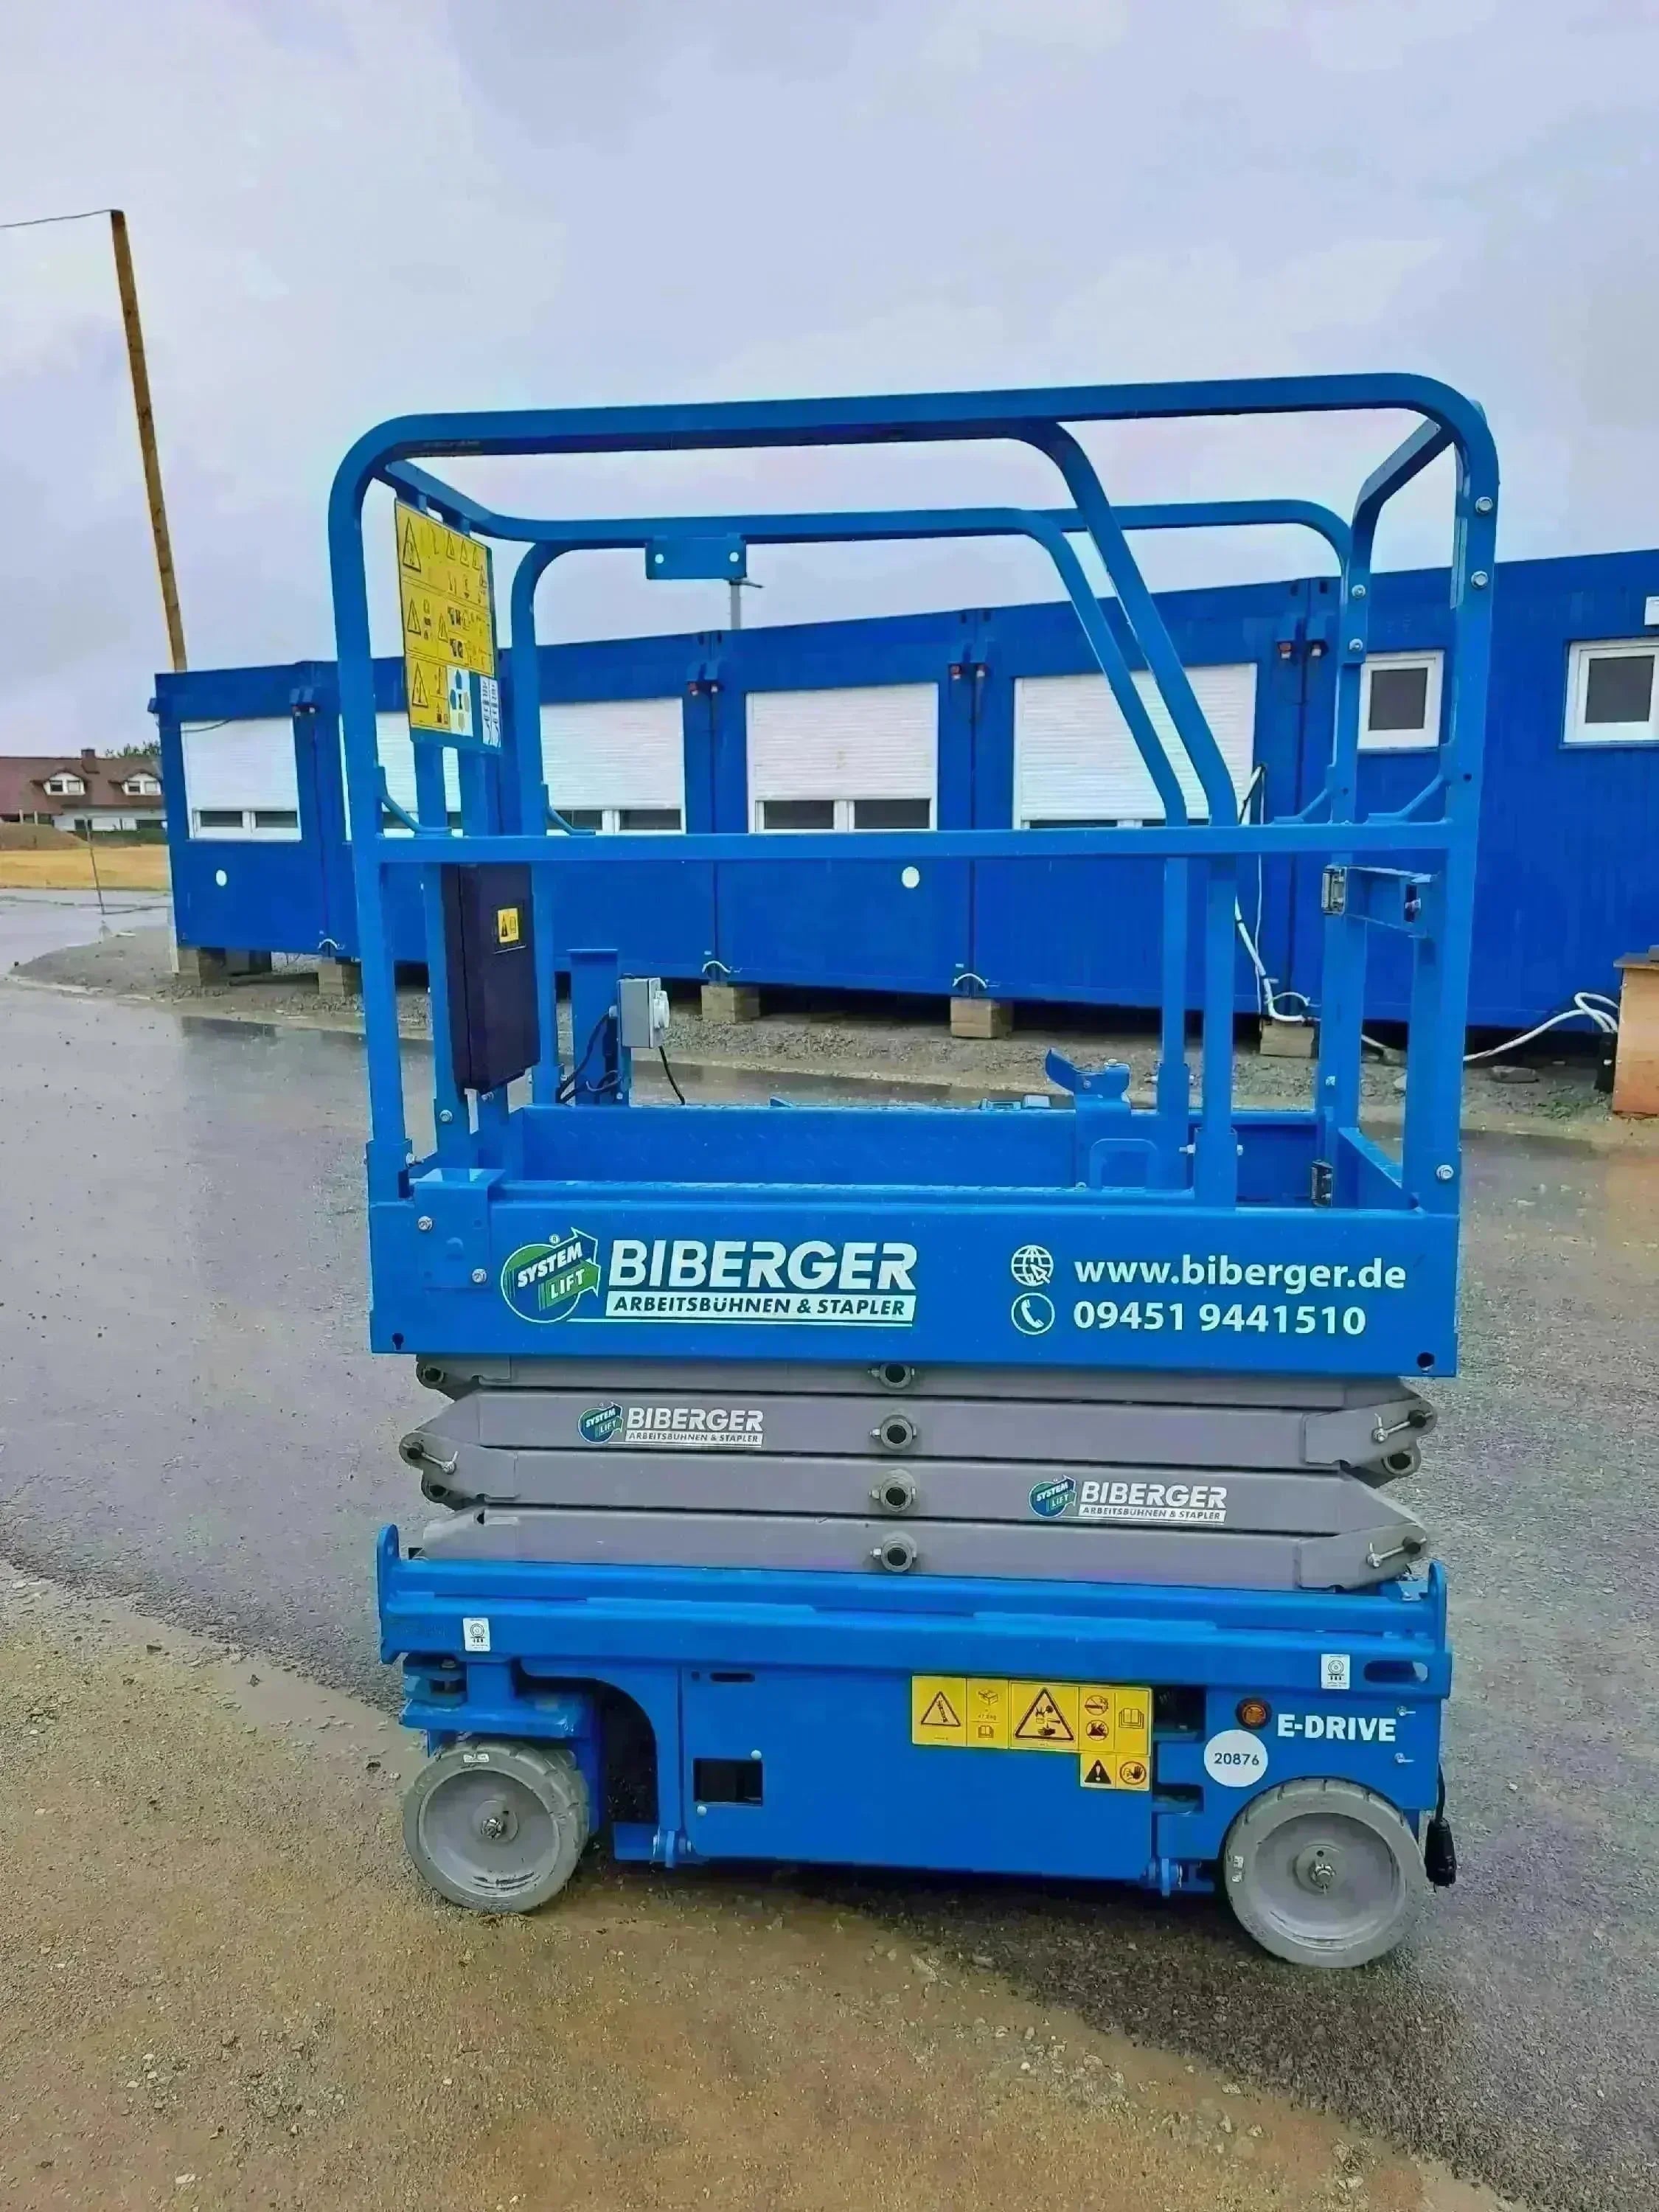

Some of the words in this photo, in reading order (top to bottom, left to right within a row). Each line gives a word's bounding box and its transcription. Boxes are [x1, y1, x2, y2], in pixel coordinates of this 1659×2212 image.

[517, 1242, 584, 1289] SYSTEM
[608, 1239, 917, 1290] BIBERGER
[1074, 1254, 1407, 1295] www.biberger.de
[549, 1270, 586, 1300] LIFT
[613, 1295, 790, 1314] ARBEITSBÜHNEN
[796, 1298, 812, 1314] &
[816, 1298, 905, 1315] STAPLER
[1074, 1301, 1184, 1330] 09451
[1199, 1303, 1366, 1335] 9441510
[585, 1408, 616, 1428] SYSTEM
[599, 1420, 616, 1433] LIFT
[626, 1408, 764, 1432] BIBERGER
[719, 1434, 759, 1443] STAPLER
[1036, 1480, 1068, 1502] SYSTEM
[1051, 1495, 1069, 1508] LIFT
[1080, 1481, 1228, 1509] BIBERGER
[1178, 1510, 1221, 1520] STAPLER
[1277, 1713, 1397, 1743] E-DRIVE
[1214, 1751, 1259, 1767] 20876
